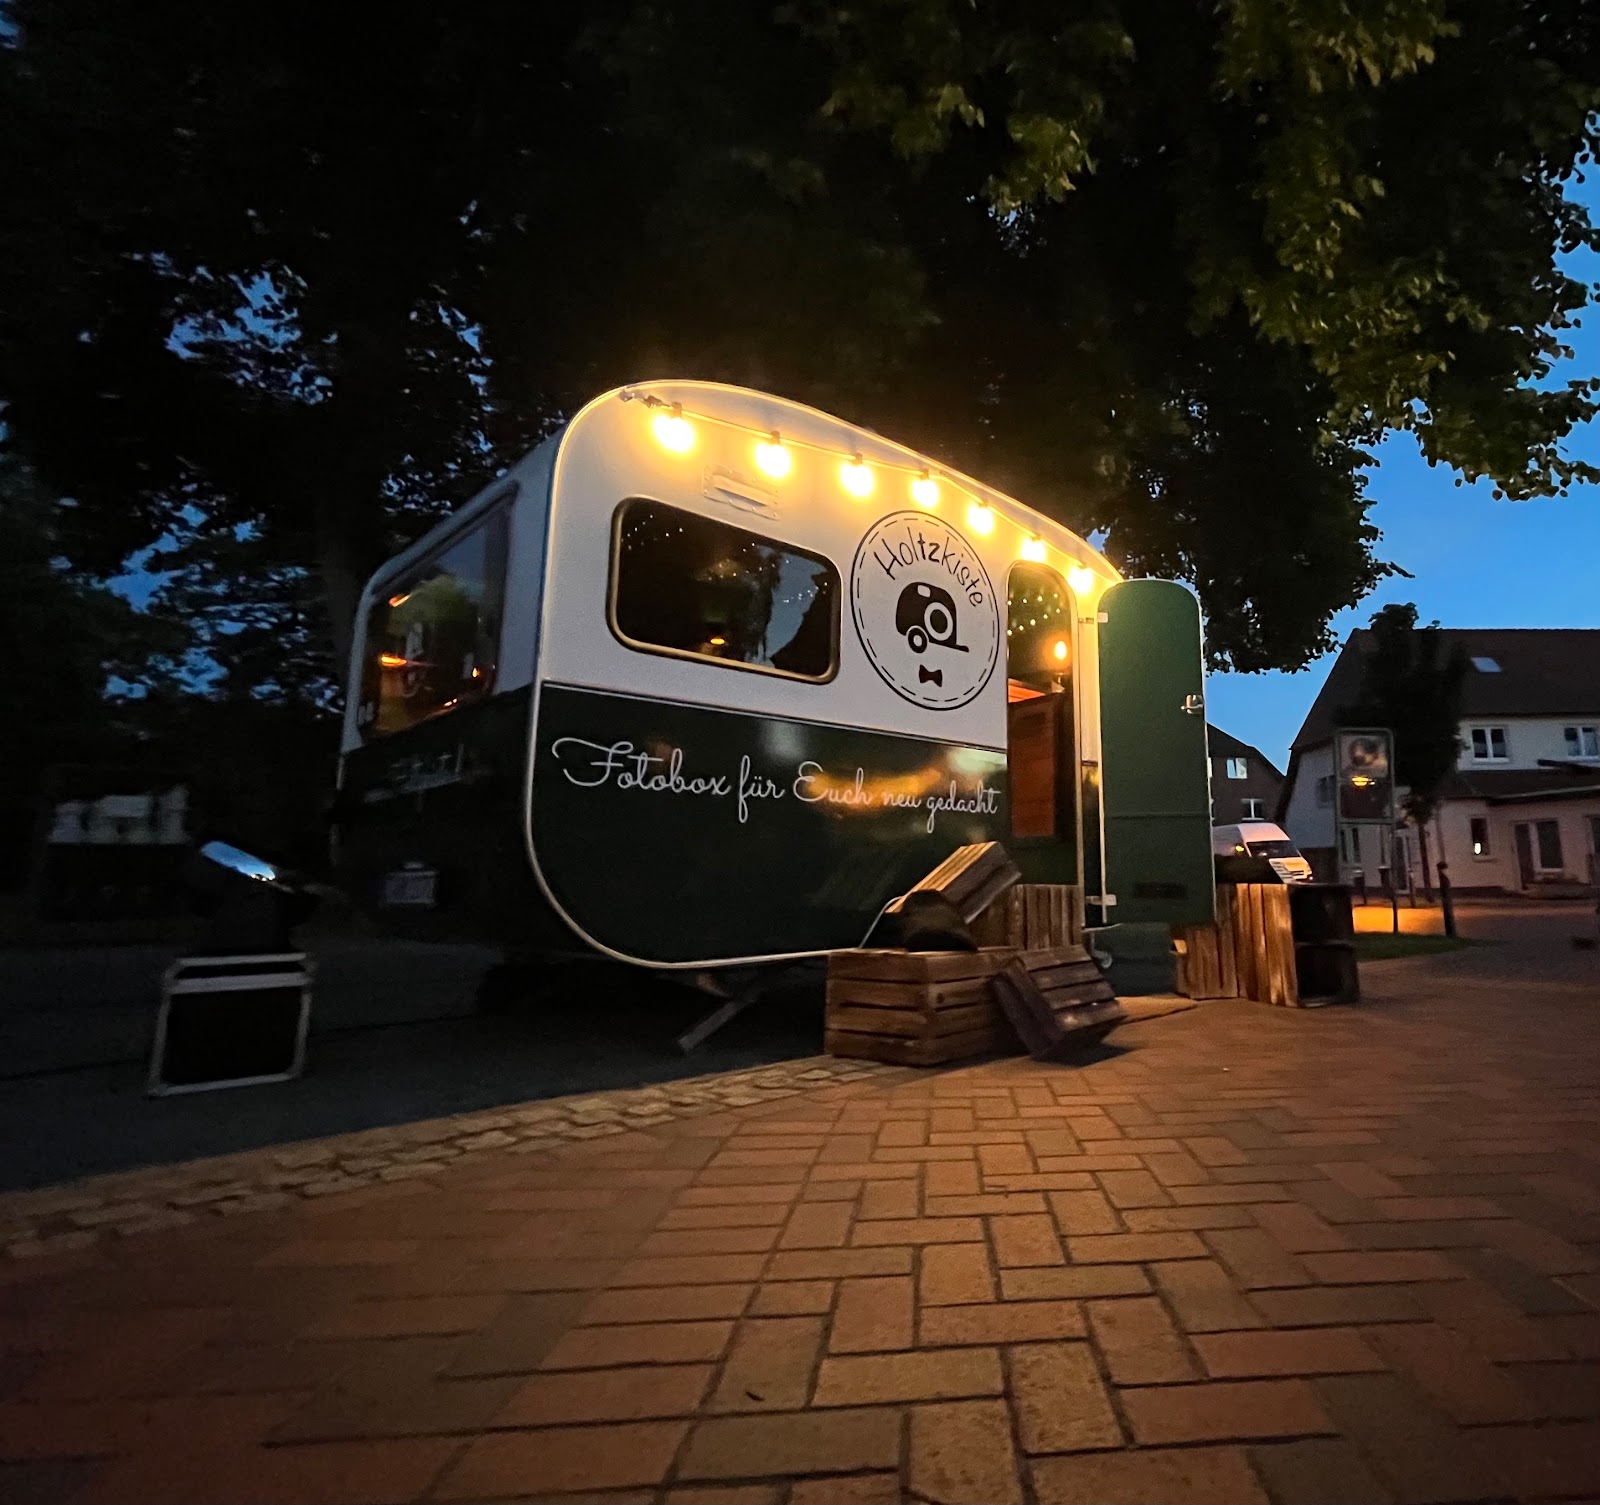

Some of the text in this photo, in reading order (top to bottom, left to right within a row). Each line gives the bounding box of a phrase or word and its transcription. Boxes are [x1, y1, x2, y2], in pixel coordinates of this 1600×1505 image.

[873, 526, 984, 608] Holtzkiste
[551, 736, 1001, 833] Fotobox für Euch neu gedacht
